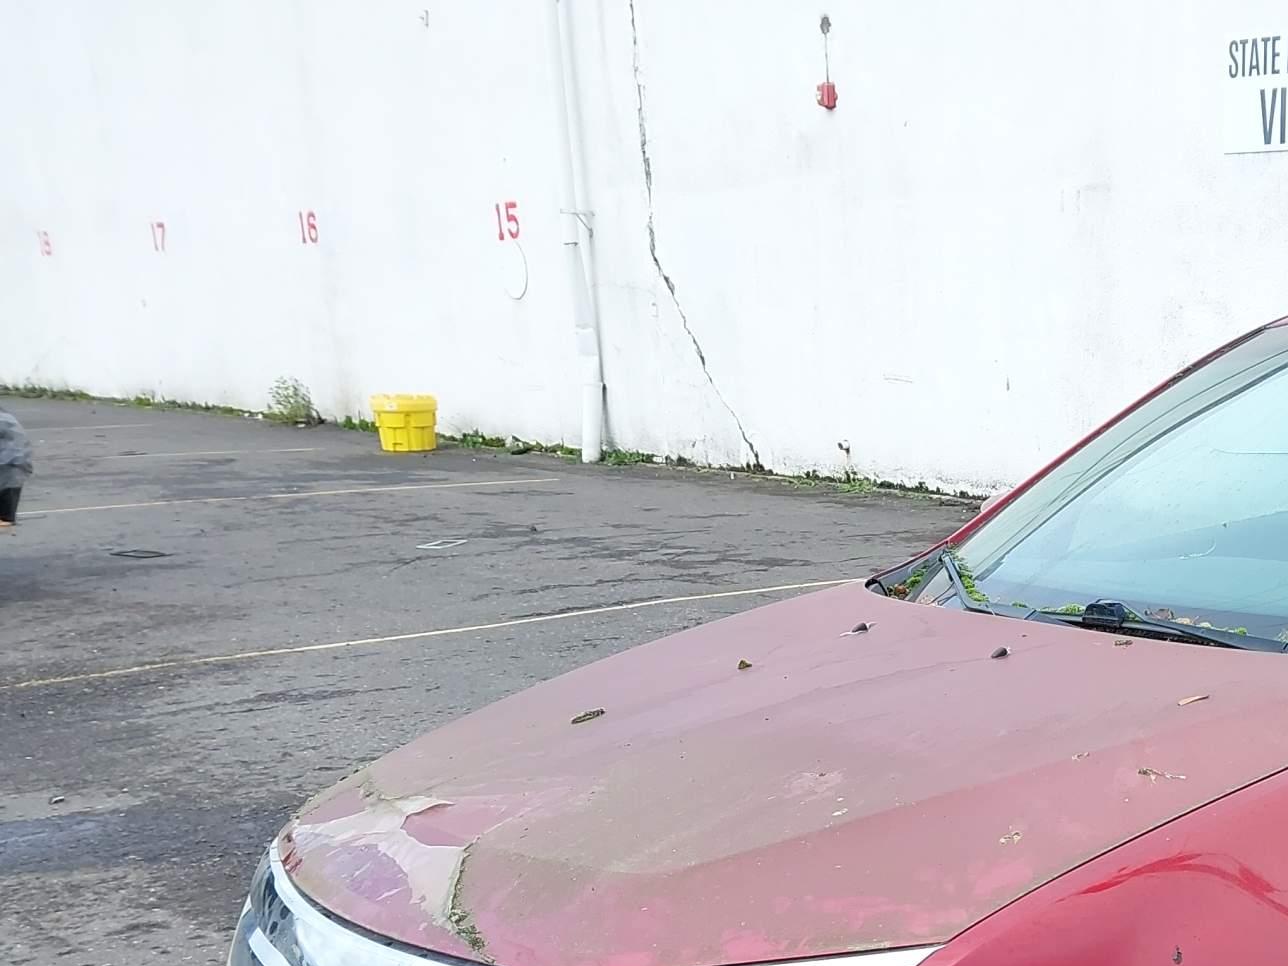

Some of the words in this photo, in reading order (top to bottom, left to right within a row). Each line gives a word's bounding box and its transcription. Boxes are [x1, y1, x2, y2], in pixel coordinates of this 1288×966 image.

[1229, 36, 1281, 78] STATE
[149, 221, 166, 252] 17
[299, 211, 318, 244] 16
[495, 201, 520, 241] 15
